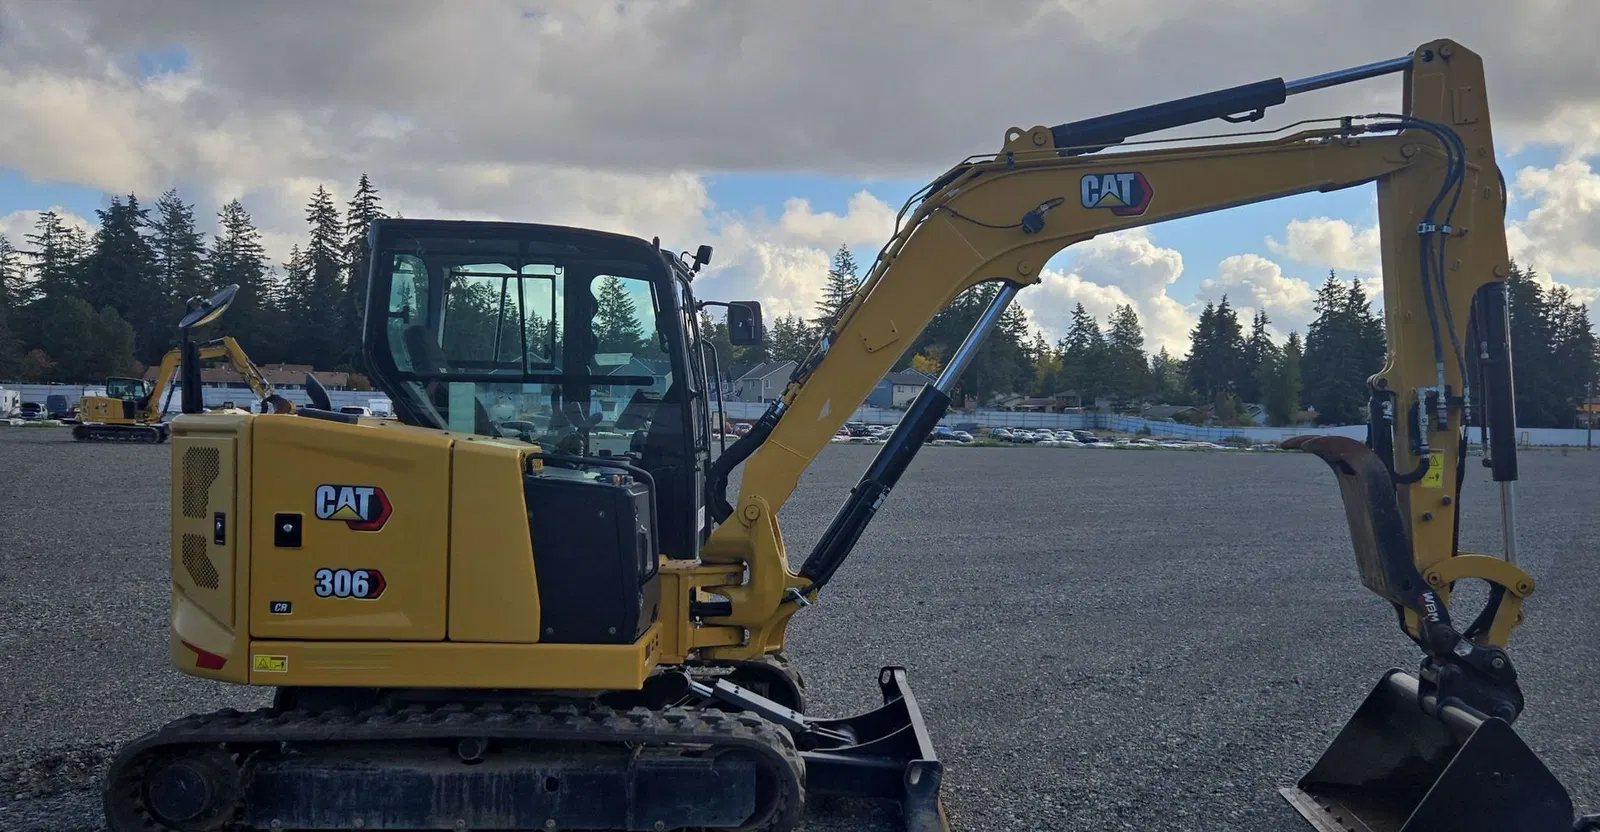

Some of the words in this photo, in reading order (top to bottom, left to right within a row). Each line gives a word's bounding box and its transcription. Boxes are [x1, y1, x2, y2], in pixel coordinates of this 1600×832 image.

[1081, 173, 1134, 208] CAT
[316, 485, 374, 520] CAT
[316, 569, 369, 597] 306
[275, 603, 288, 612] CR
